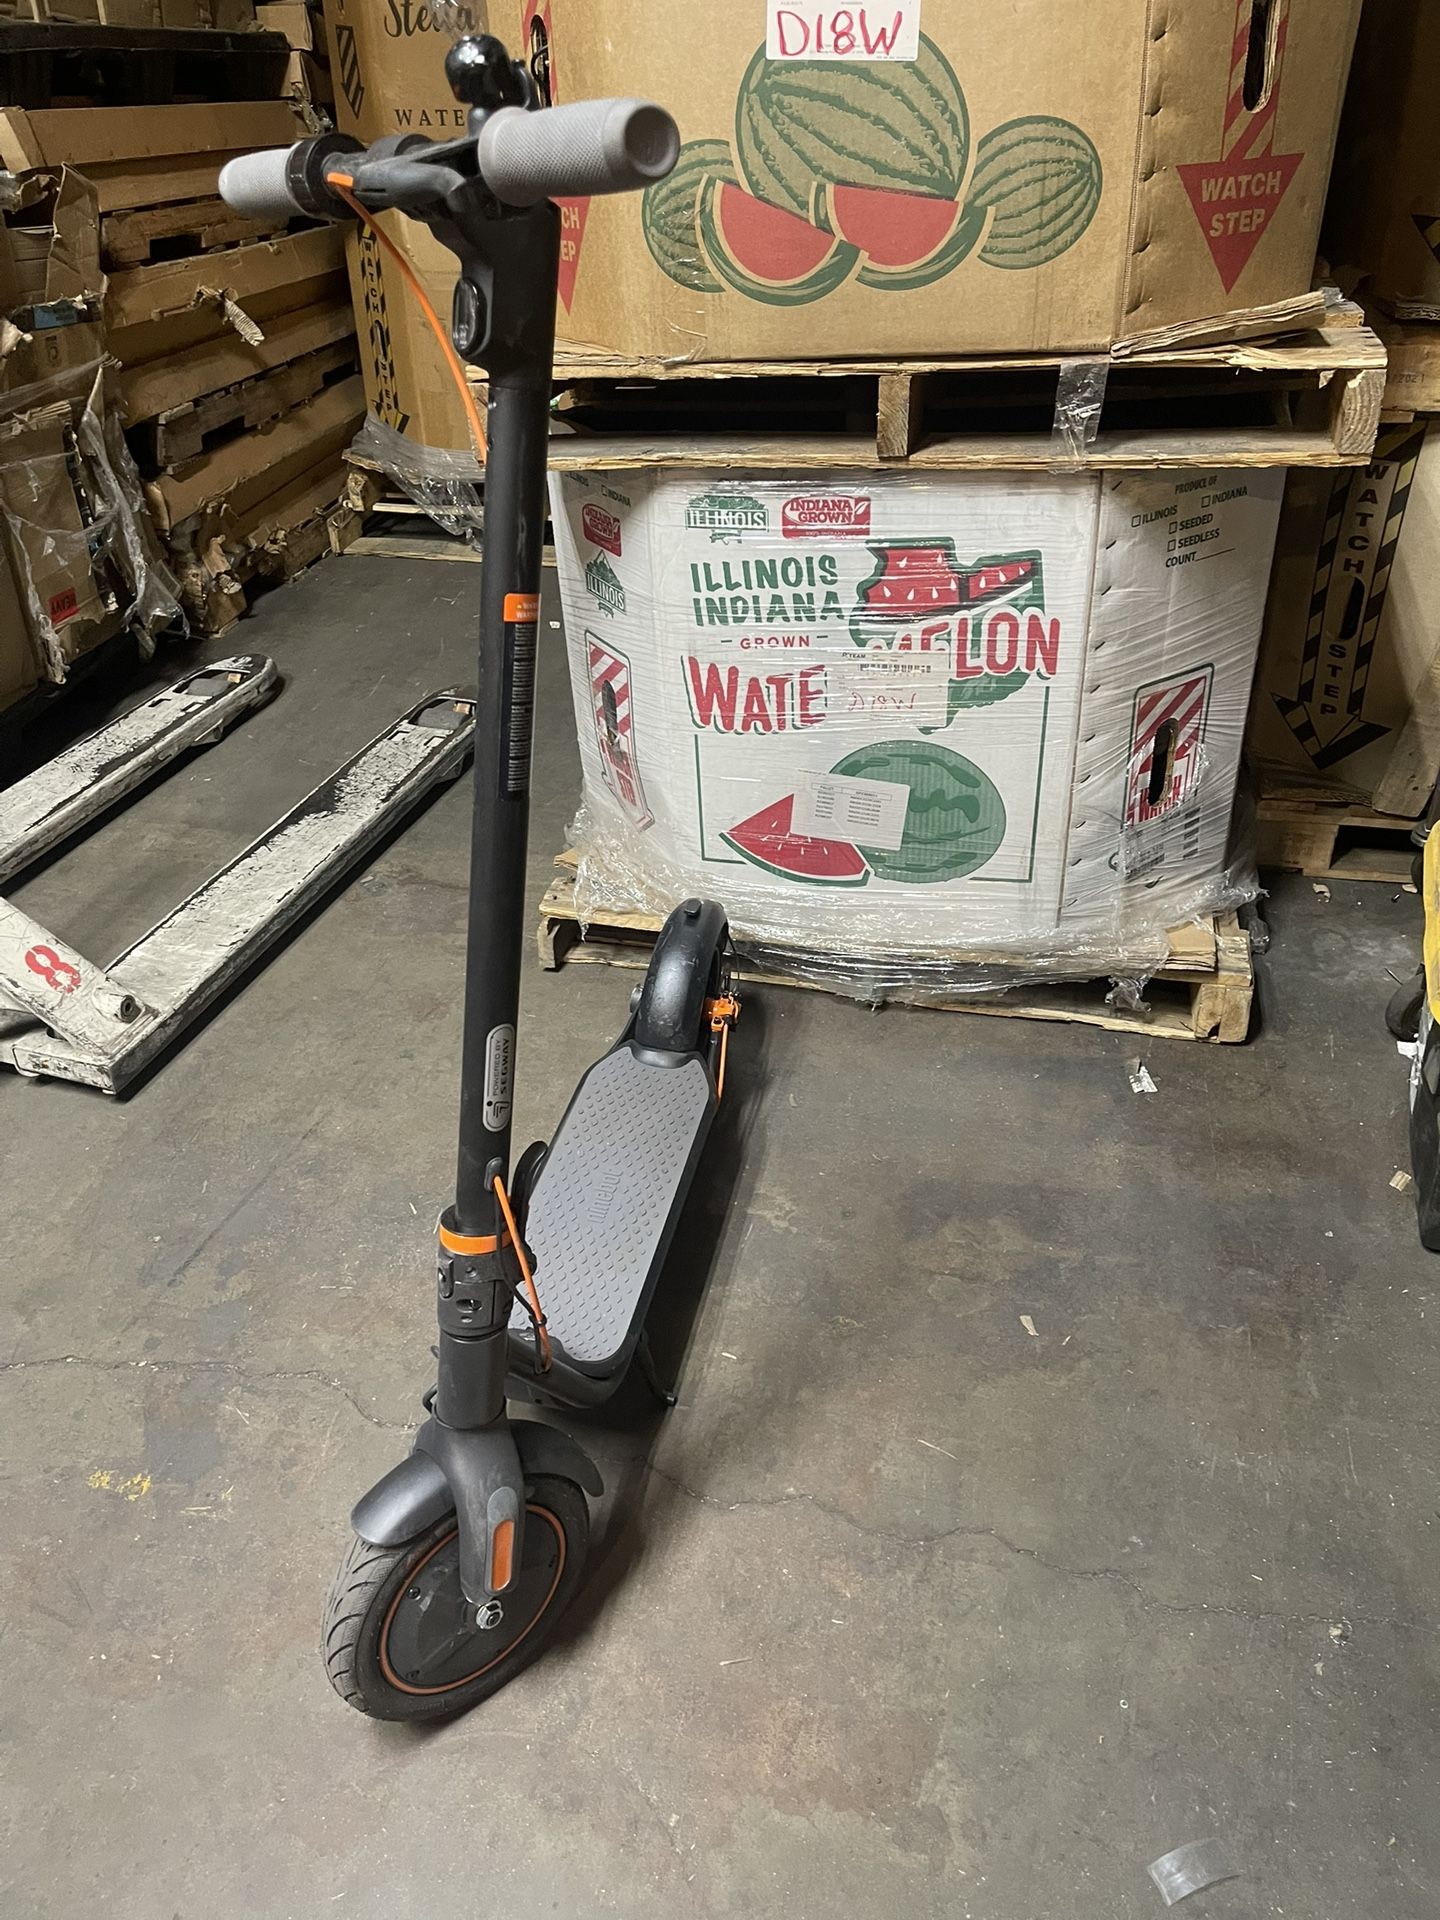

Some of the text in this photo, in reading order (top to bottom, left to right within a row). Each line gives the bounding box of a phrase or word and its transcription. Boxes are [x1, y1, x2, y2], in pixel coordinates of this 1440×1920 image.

[777, 8, 903, 56] D18W
[394, 109, 465, 126] WATE
[1201, 170, 1282, 202] WATCH
[1209, 208, 1265, 237] STEP
[561, 240, 576, 262] EP
[1174, 478, 1207, 494] PRODUCE
[1211, 486, 1248, 505] INDIANA
[789, 499, 853, 512] INDIANA
[1142, 505, 1178, 524] ILLINOIS
[798, 511, 853, 523] GROWN
[1179, 513, 1214, 531] SEEDED
[1343, 464, 1390, 574] WATCH
[1178, 528, 1220, 549] SEEDLESS
[1165, 551, 1197, 568] COUNT
[690, 554, 838, 593] ILLINOIS
[587, 573, 625, 612] ILLINOIS
[692, 590, 846, 627] INDIANA
[740, 635, 810, 649] GROWN
[1319, 643, 1347, 716] STEP
[25, 944, 81, 994] 8
[501, 1038, 510, 1094] SEGWAY
